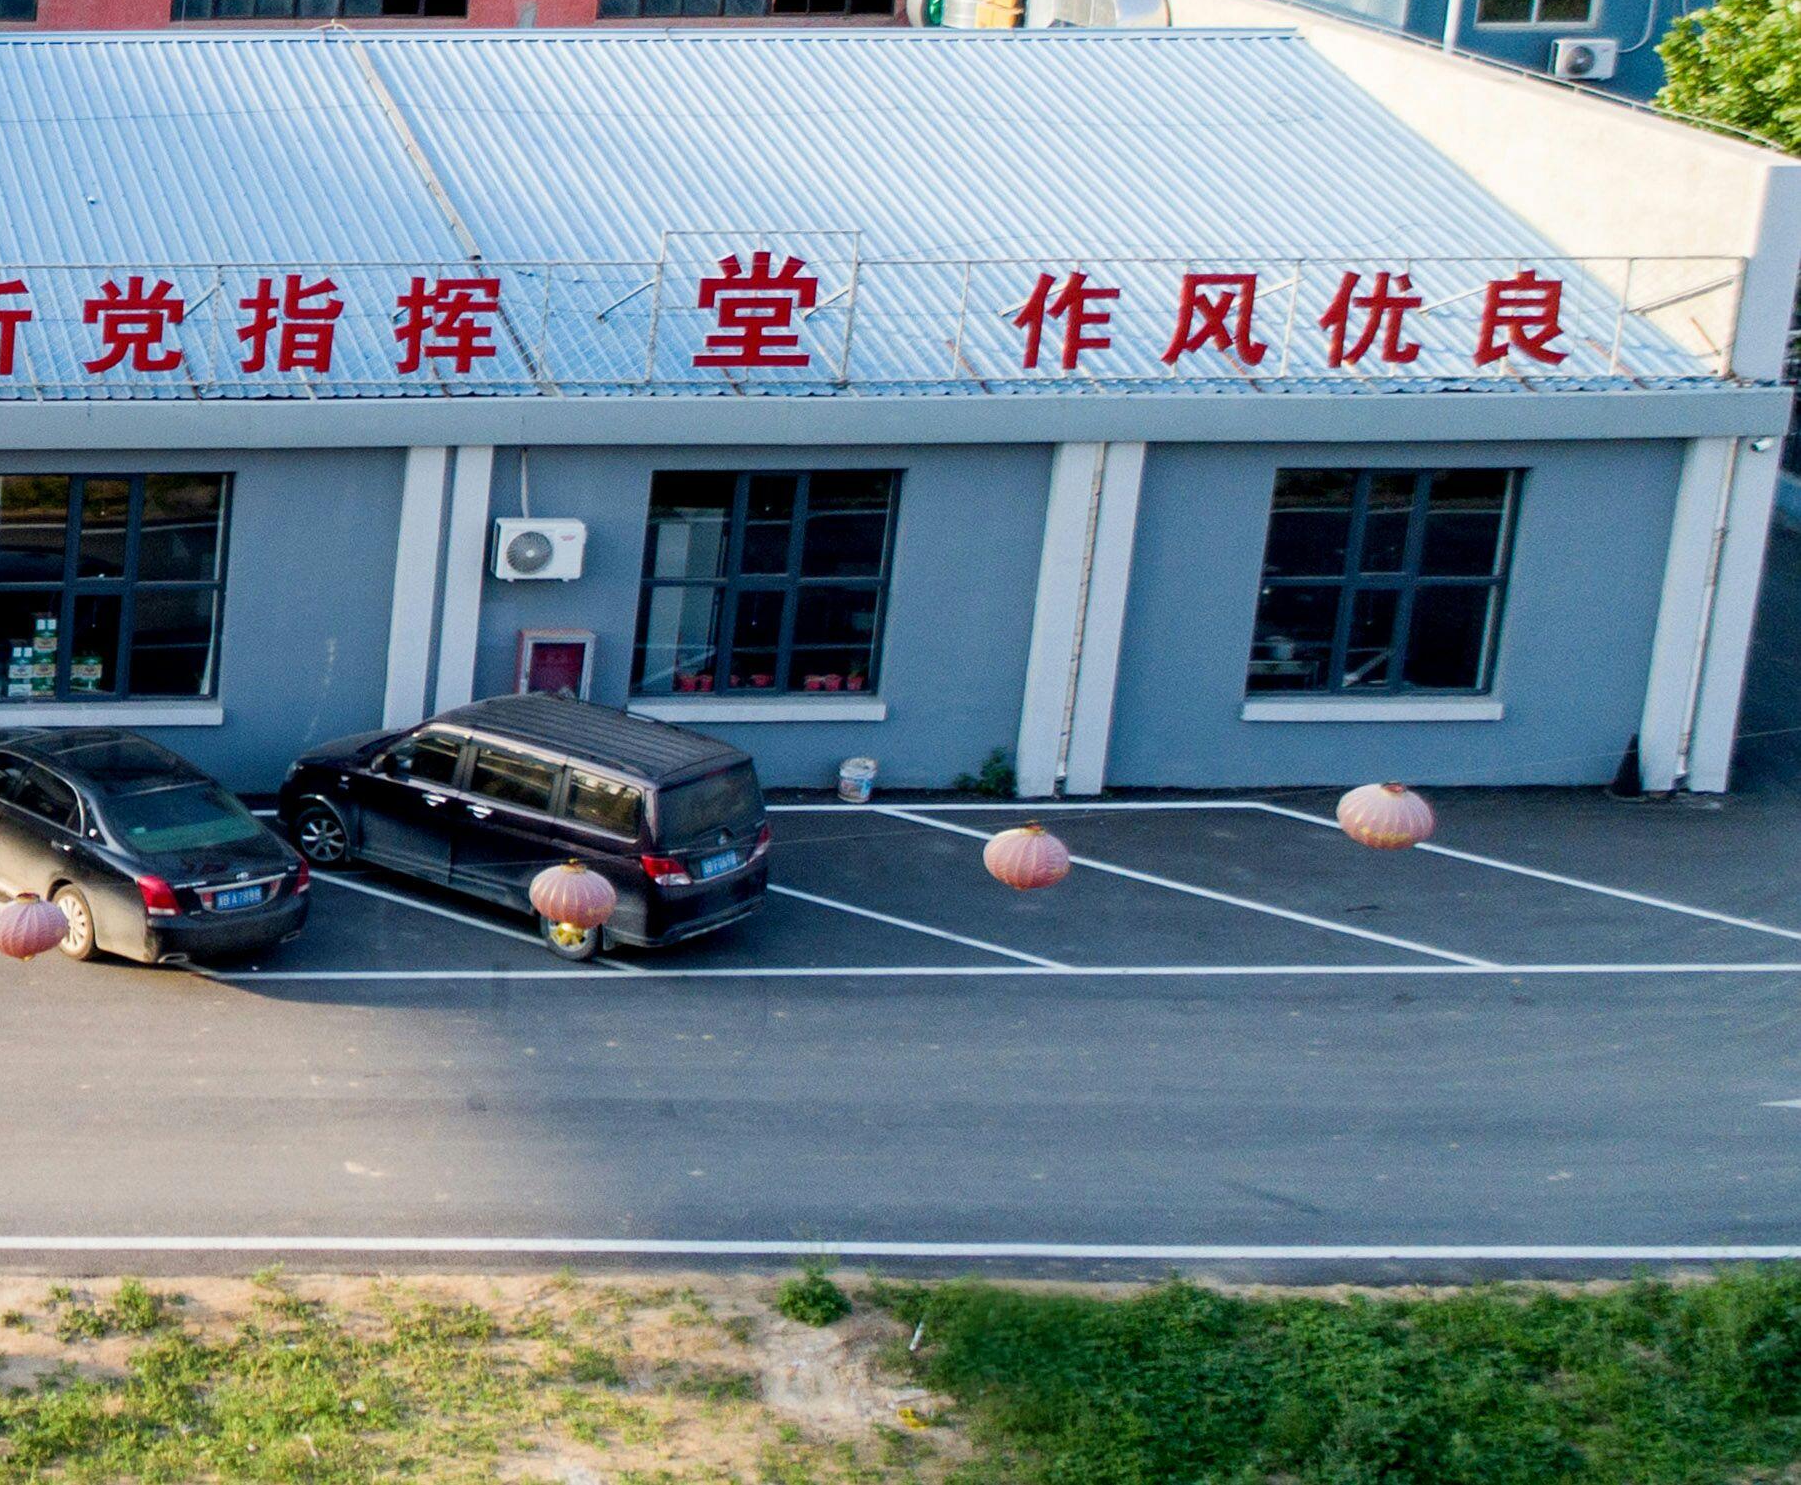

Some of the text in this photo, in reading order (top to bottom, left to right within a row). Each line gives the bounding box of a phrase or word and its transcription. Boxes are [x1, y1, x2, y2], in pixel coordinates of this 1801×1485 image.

[694, 251, 817, 368] 堂
[1012, 271, 1566, 369] 作风优良
